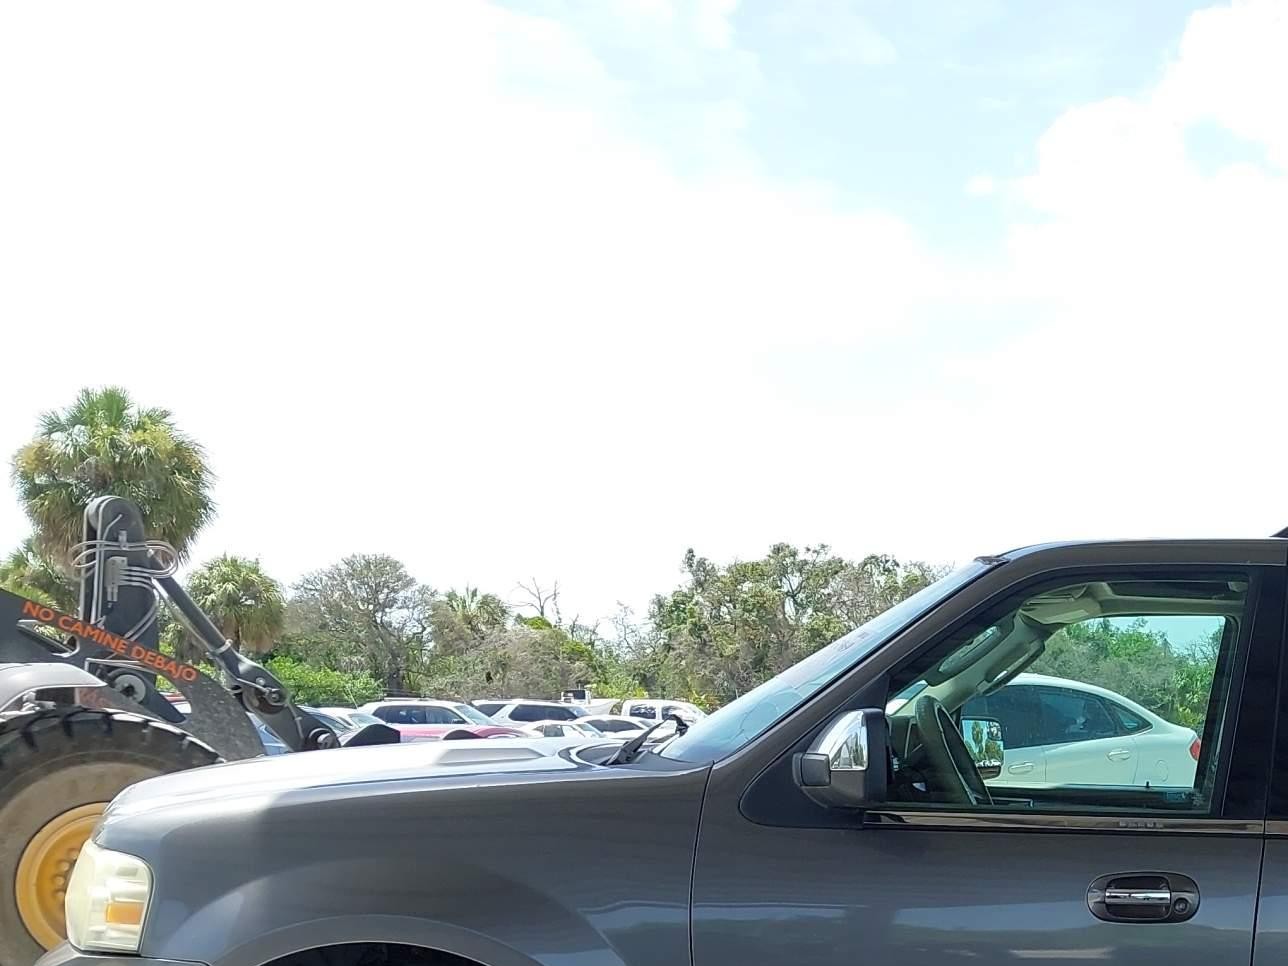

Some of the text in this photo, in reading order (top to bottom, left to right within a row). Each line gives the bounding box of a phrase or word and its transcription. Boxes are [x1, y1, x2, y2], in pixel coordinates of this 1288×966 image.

[23, 600, 198, 682] NO CAMINE DEBAJO
